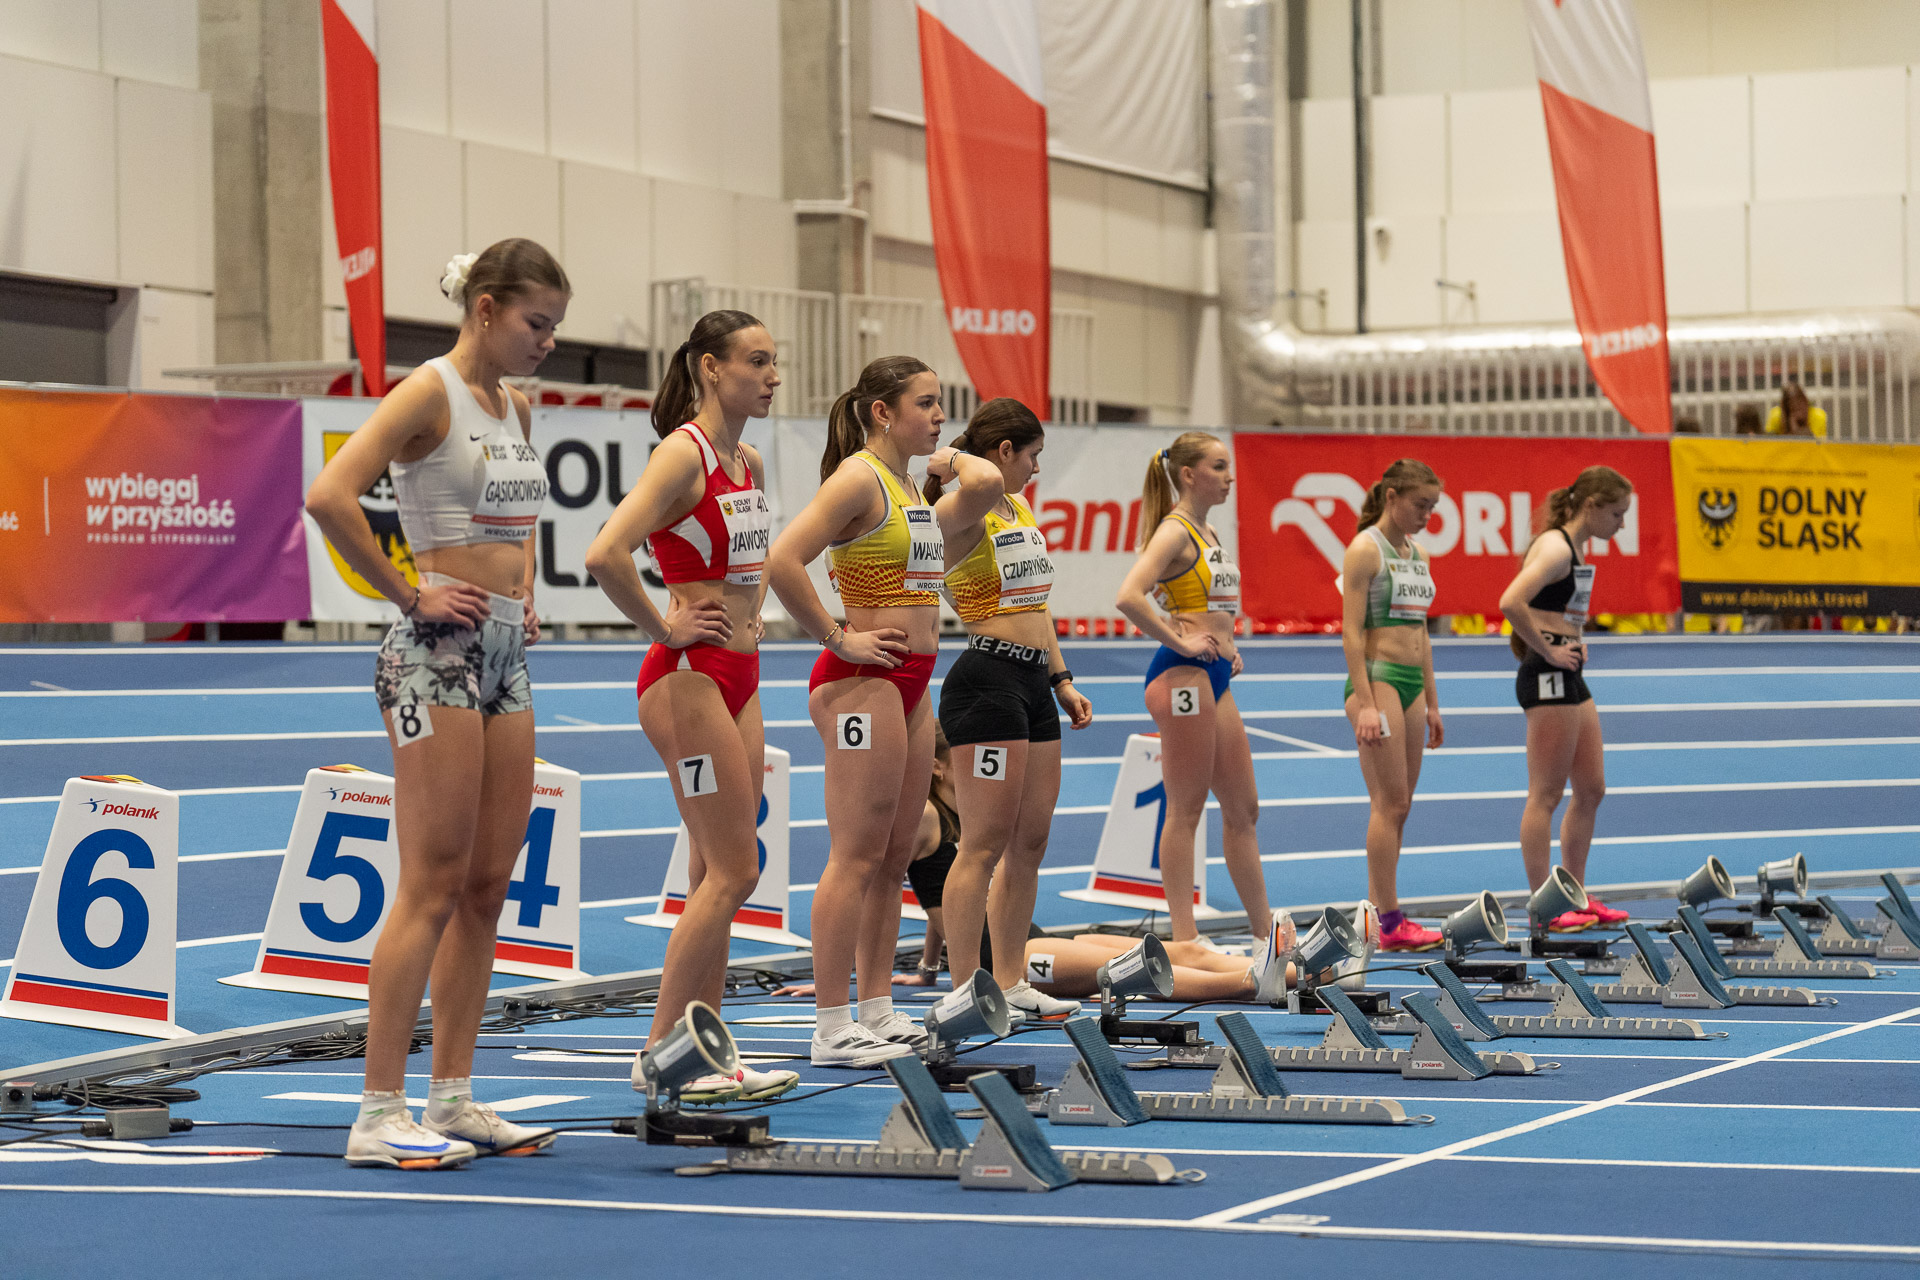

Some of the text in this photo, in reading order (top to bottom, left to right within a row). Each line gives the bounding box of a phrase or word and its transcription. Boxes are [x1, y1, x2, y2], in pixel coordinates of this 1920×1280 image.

[85, 472, 199, 506] wybiegaj
[485, 480, 548, 508] GĄSIOROWSKA
[733, 498, 751, 507] DOLNY
[1758, 486, 1867, 517] DOLNY
[112, 499, 236, 532] przyszłość
[87, 533, 236, 545] PROGRAM STYPENDIALNY
[1757, 514, 1864, 554] ŚLĄSK
[1002, 555, 1055, 580] CZUPRYŃSKA
[1397, 583, 1434, 599] JEWUŁA
[995, 640, 1036, 661] PRO
[1546, 674, 1556, 695] 1
[1178, 690, 1193, 713] 3
[400, 705, 422, 739] 8
[844, 716, 864, 747] 6
[684, 758, 704, 793] 7
[980, 749, 999, 777] 5
[299, 811, 390, 943] 5
[506, 806, 560, 928] 4
[57, 829, 155, 970] 6
[1030, 960, 1051, 978] 4
